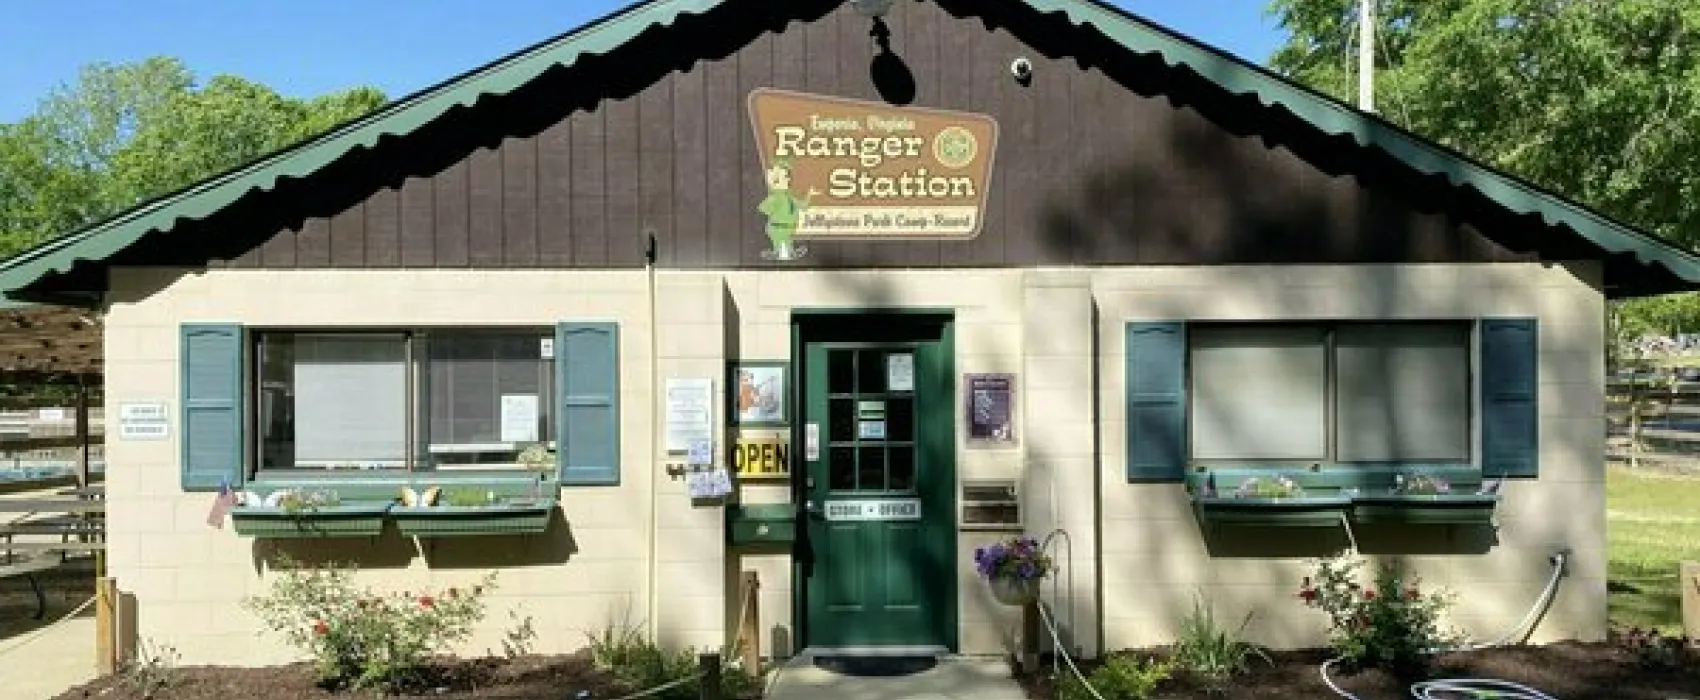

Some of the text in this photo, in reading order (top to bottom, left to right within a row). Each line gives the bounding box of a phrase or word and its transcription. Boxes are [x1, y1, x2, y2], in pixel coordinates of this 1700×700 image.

[775, 126, 923, 167] Ranger
[829, 168, 976, 197] Station
[731, 443, 788, 473] OPEN
